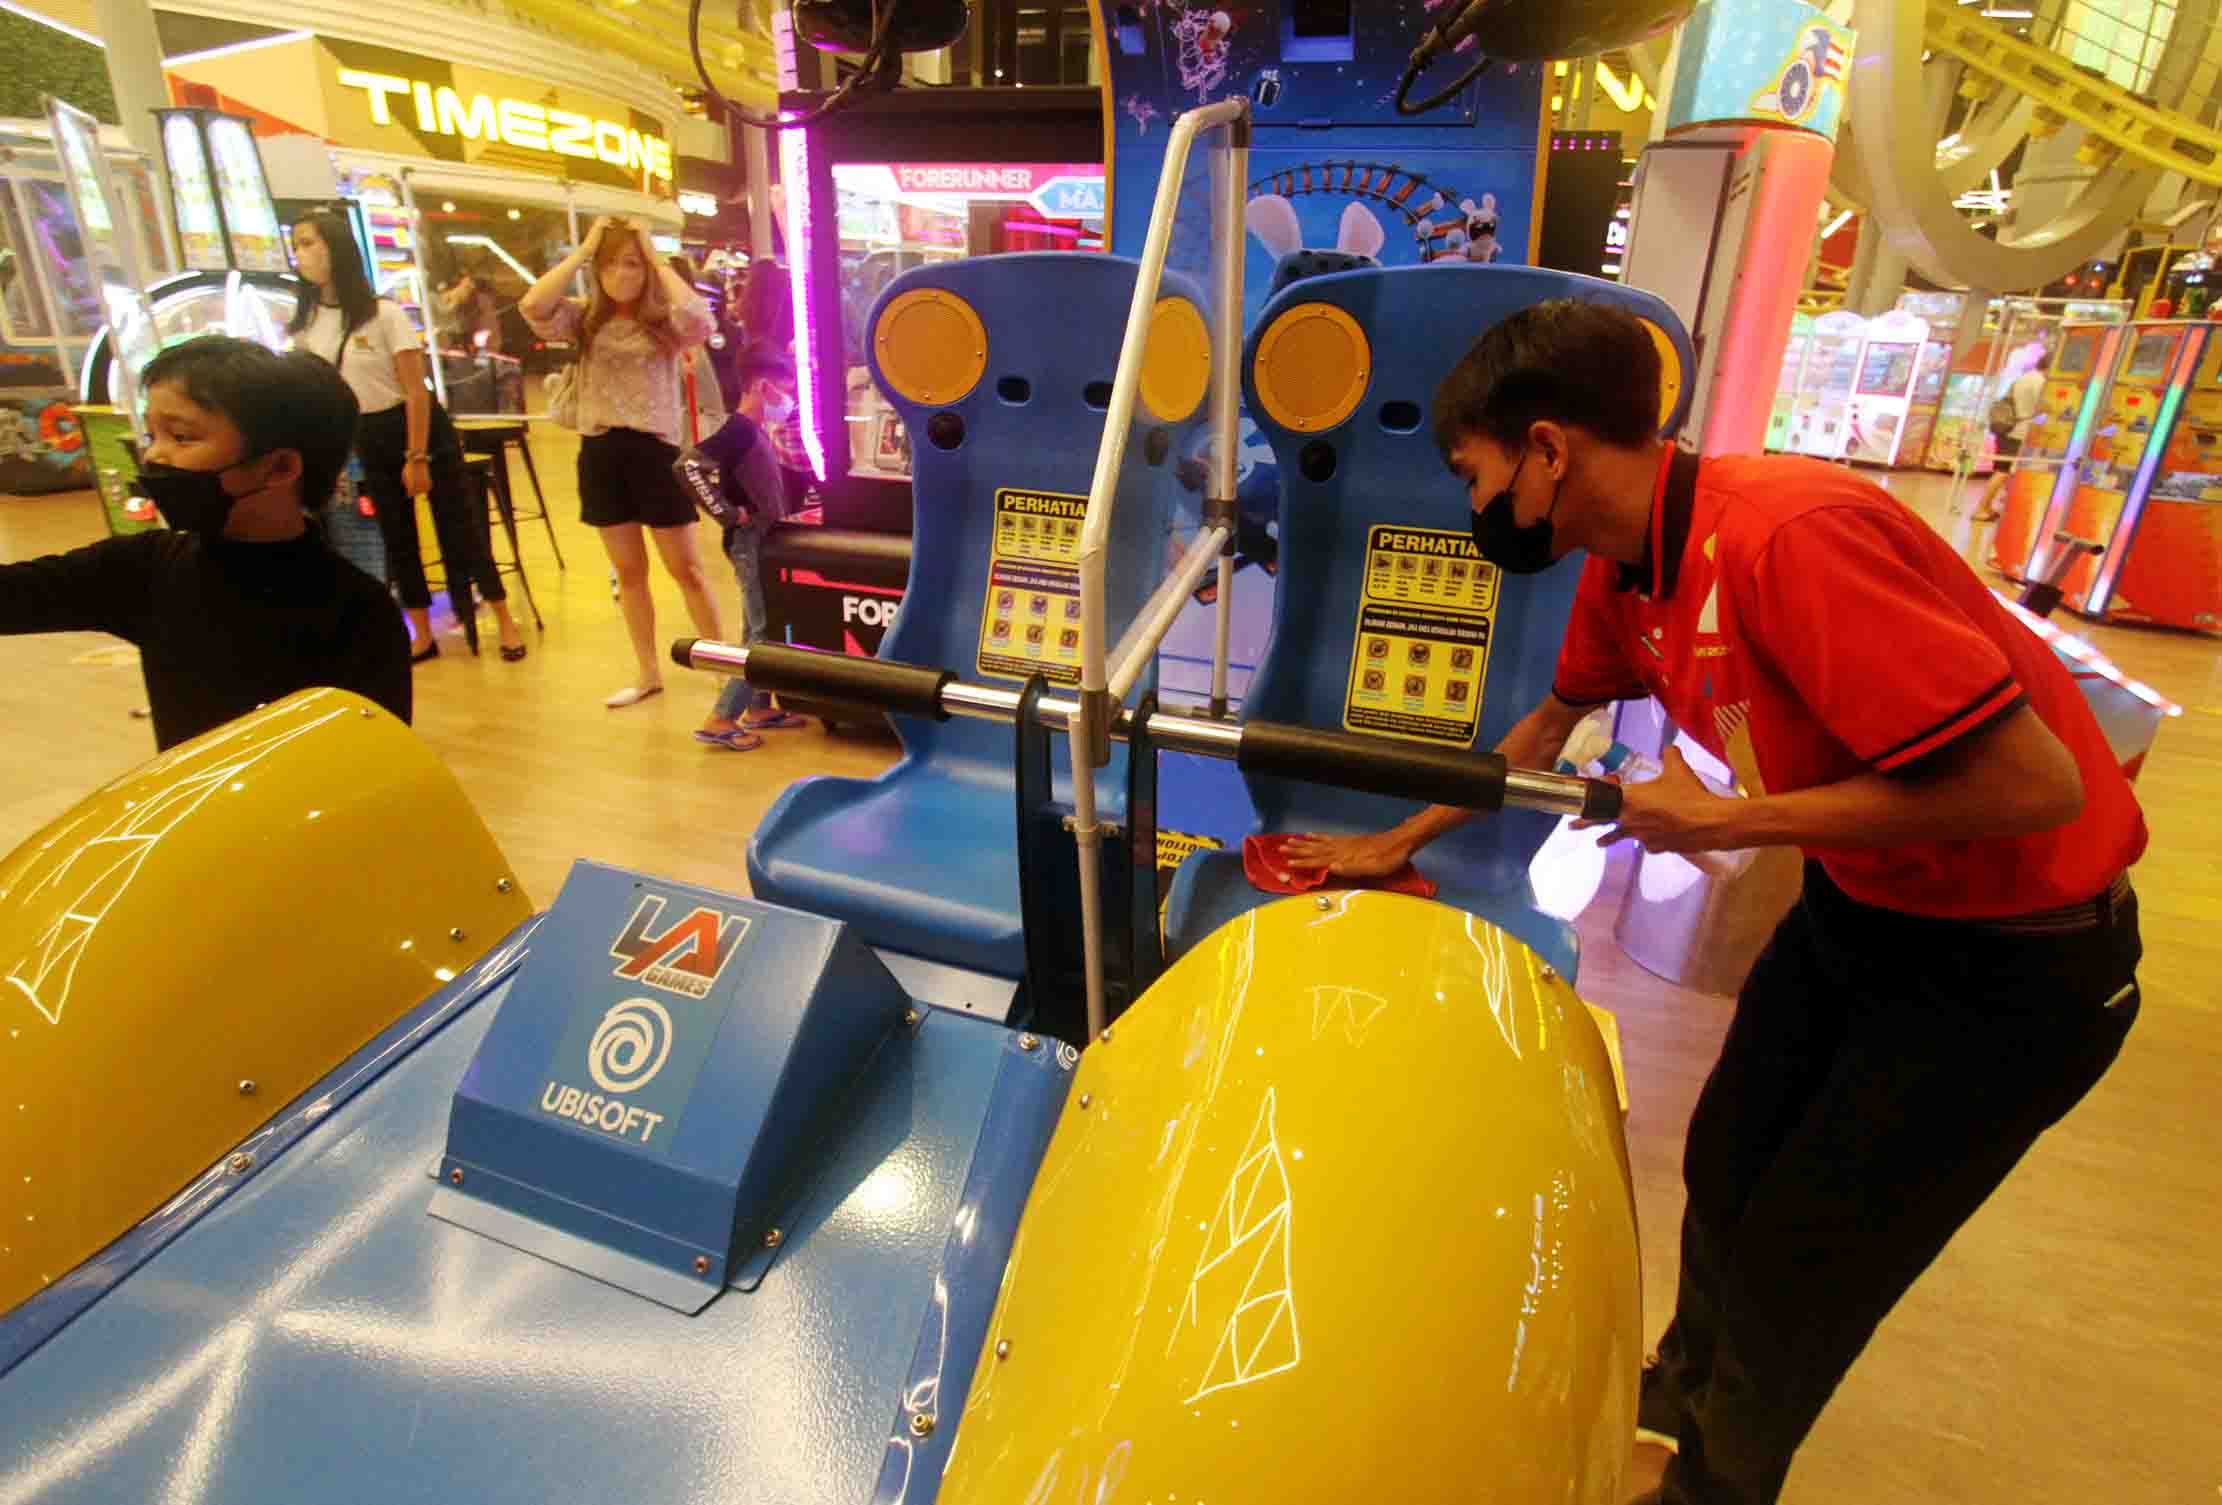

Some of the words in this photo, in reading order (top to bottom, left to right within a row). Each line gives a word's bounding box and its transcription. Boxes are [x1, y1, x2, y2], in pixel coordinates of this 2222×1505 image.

[339, 69, 672, 180] TIMEZONE
[898, 167, 1032, 189] FORERUNNER
[1058, 188, 1105, 209] MA
[1003, 494, 1088, 517] PERHATIA
[1378, 531, 1485, 558] PERHATIA
[644, 966, 708, 997] GAMES
[540, 1081, 664, 1143] UBISOFT
